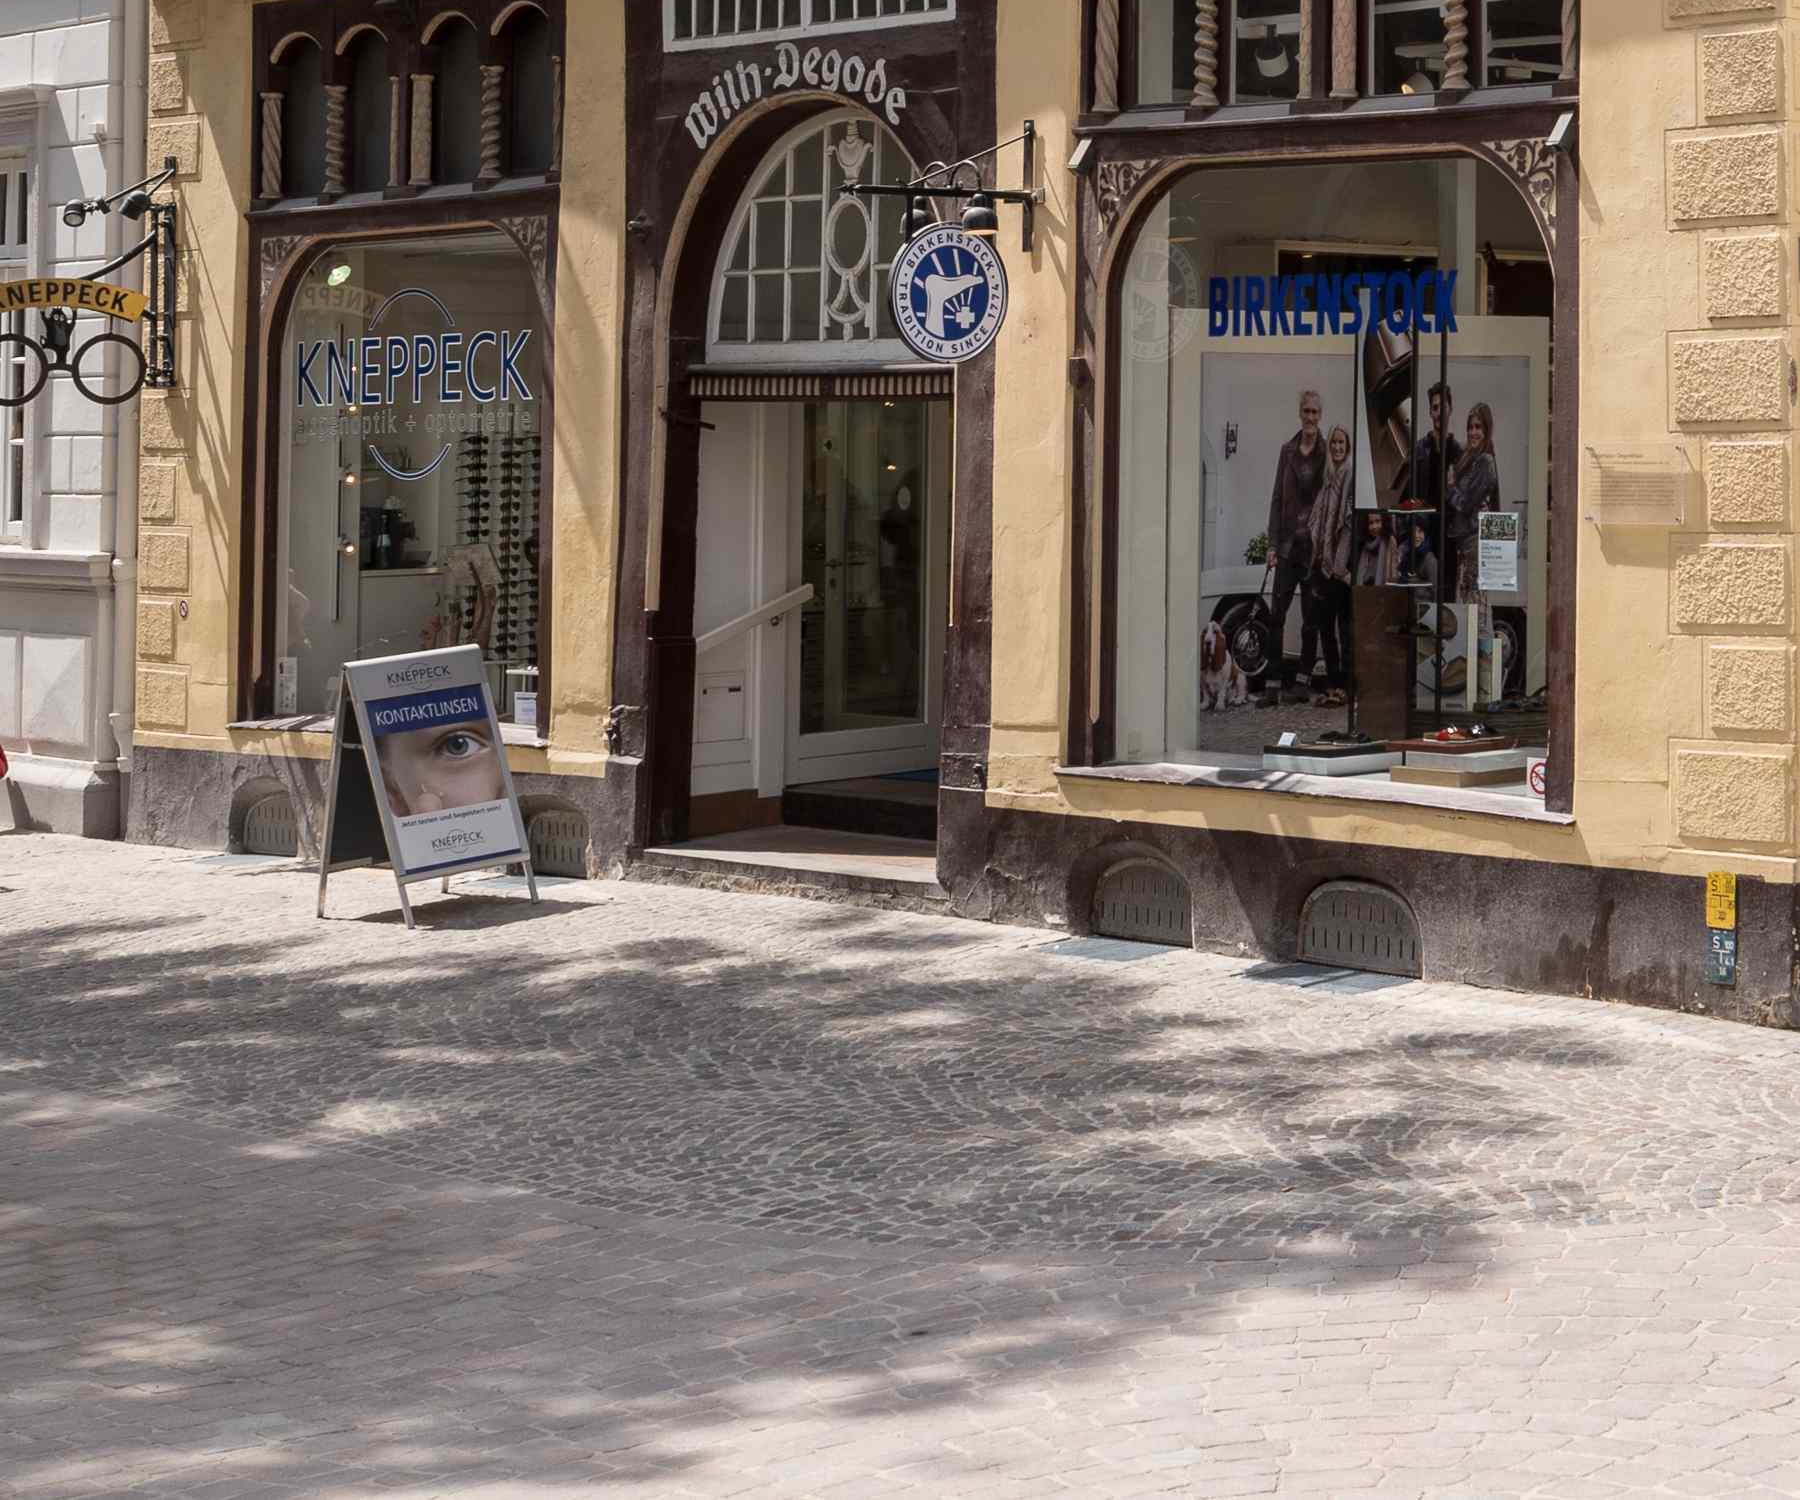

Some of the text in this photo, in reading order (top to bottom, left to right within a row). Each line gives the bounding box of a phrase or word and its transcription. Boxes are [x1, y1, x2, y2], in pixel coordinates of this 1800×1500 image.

[906, 232, 995, 269] BIRKENSTOCK
[0, 282, 128, 313] NEPPECK
[1208, 269, 1458, 337] BIRKENSTOCK
[899, 282, 1000, 354] TRADITION SINCE 1774
[297, 329, 533, 407] KNEPPECK
[386, 665, 451, 684] KNEPPECK
[375, 696, 479, 725] KONTAKTLINSEN
[431, 831, 484, 848] KNEPPECK
[1712, 935, 1720, 950] S
